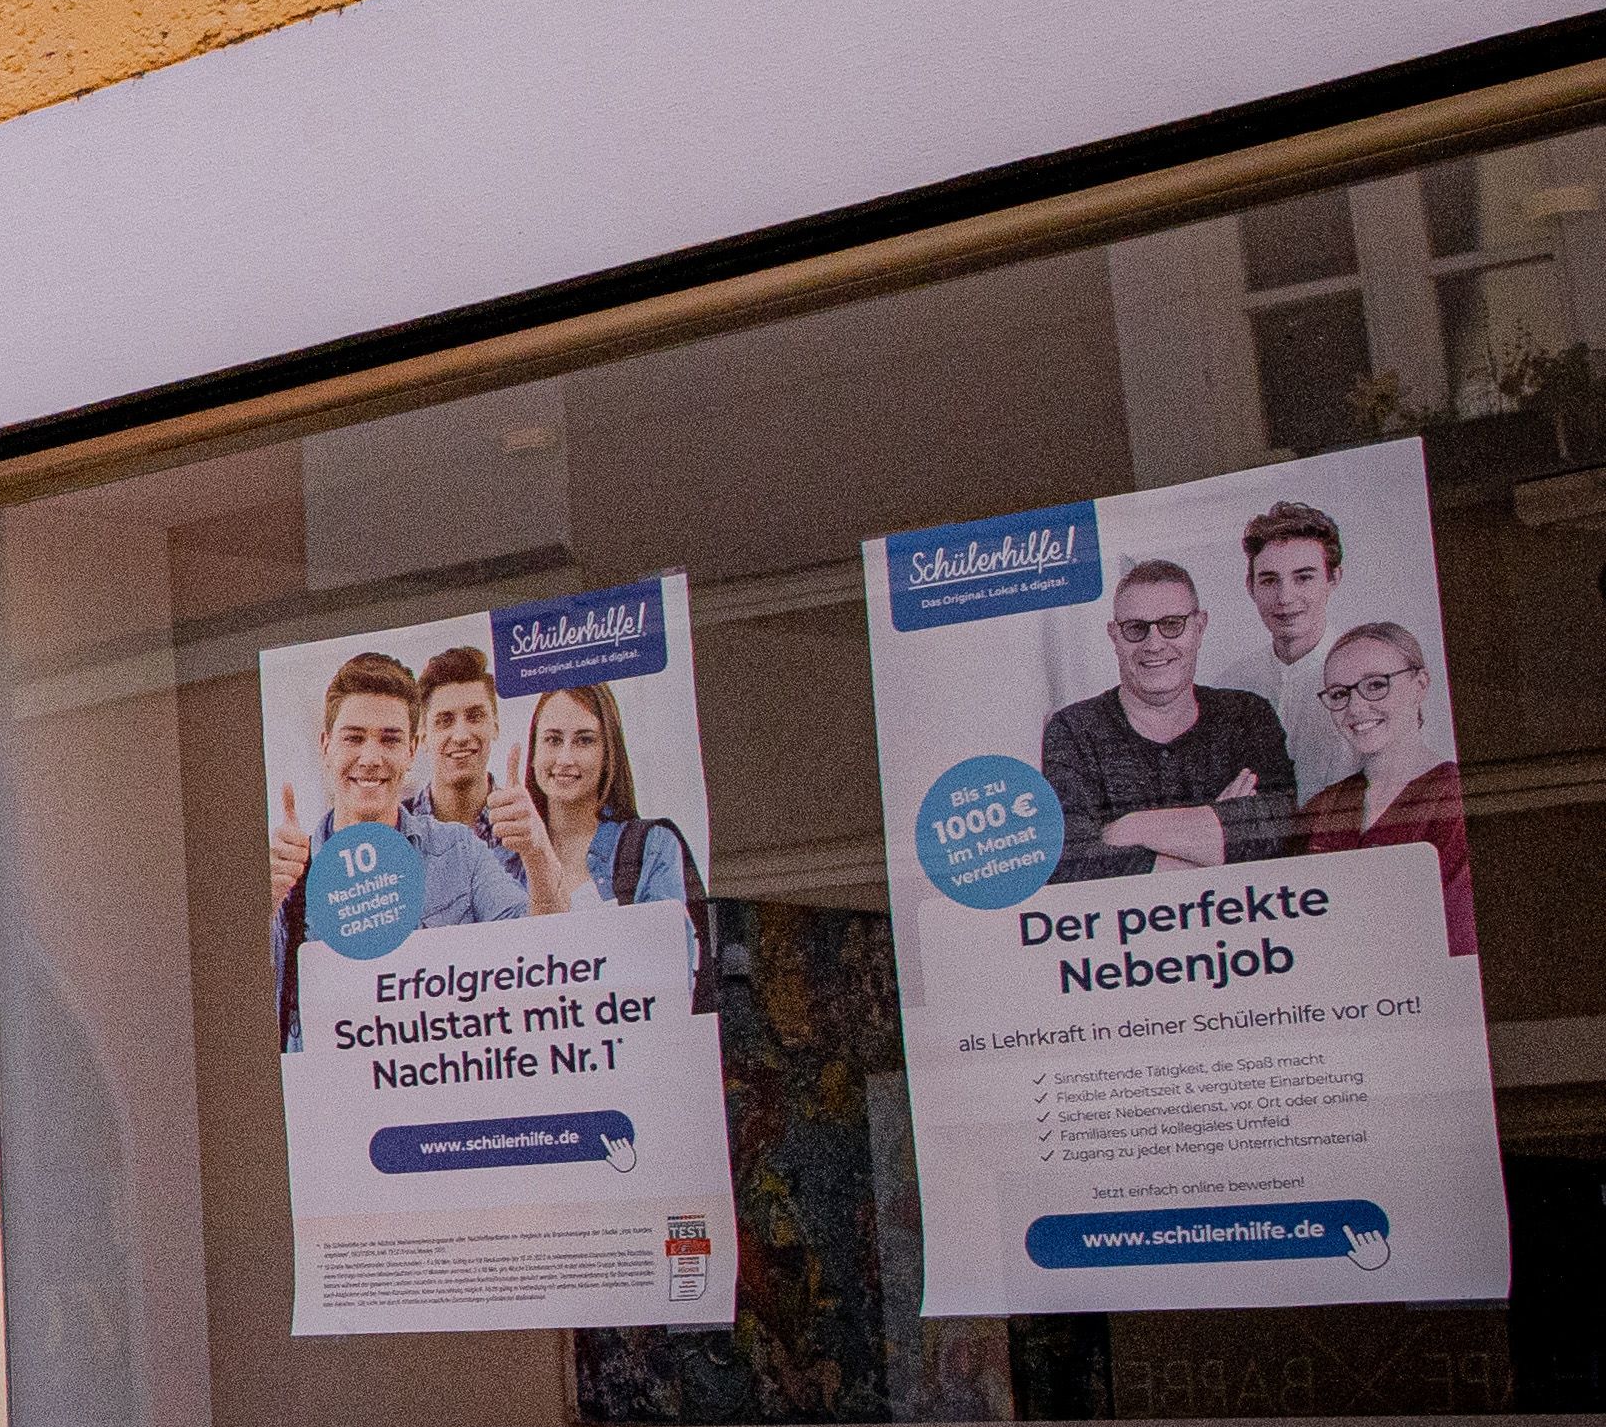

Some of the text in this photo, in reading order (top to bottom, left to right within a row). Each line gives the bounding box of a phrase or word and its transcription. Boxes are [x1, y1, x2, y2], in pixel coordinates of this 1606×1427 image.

[922, 598, 942, 609] Das
[943, 591, 987, 606] Original.
[989, 584, 1018, 598] Lokal
[1020, 582, 1028, 592] &
[520, 668, 538, 678] Das
[576, 657, 600, 668] Lokal
[601, 654, 608, 664] &
[950, 780, 1006, 807] Bis zu
[933, 792, 1038, 844] 1000 €
[339, 843, 377, 878] 10
[947, 826, 1037, 866] im Monat
[952, 849, 1046, 887] verdienen
[328, 873, 405, 905] Nachhilfe-
[338, 892, 400, 919] stunden
[1019, 885, 1330, 946] Der perfekte
[377, 954, 607, 1002] Erfolgreicher
[1060, 937, 1295, 994] Nebenjob
[335, 992, 656, 1050] Schulstart mit der
[958, 996, 1421, 1054] als Lehrkraft in deiner Schülerhilfe vor Ort!
[372, 1045, 539, 1090] Nachhilfe
[1054, 1067, 1143, 1085] Sinnstiftende
[1211, 1059, 1233, 1073] die
[1237, 1056, 1274, 1072] Spaß
[1277, 1053, 1326, 1068] macht
[1056, 1070, 1364, 1104] Flexible Arbeitszeit & vergütete Einarbeitung
[1058, 1090, 1368, 1123] Sicherer Nebenverdienst, vor Ort oder online
[420, 1129, 580, 1155] www.schülerhilfe.de
[1131, 1123, 1157, 1138] und
[1161, 1119, 1233, 1136] kollegiales
[1237, 1114, 1291, 1131] Umfeld
[1062, 1129, 1368, 1163] Zugang zu jeder Menge Unterrichtsmaterial
[1092, 1175, 1305, 1200] Jetzt einfach online bewerben!
[669, 1225, 704, 1239] TEST
[1082, 1219, 1326, 1248] www.schülerhilfe.de
